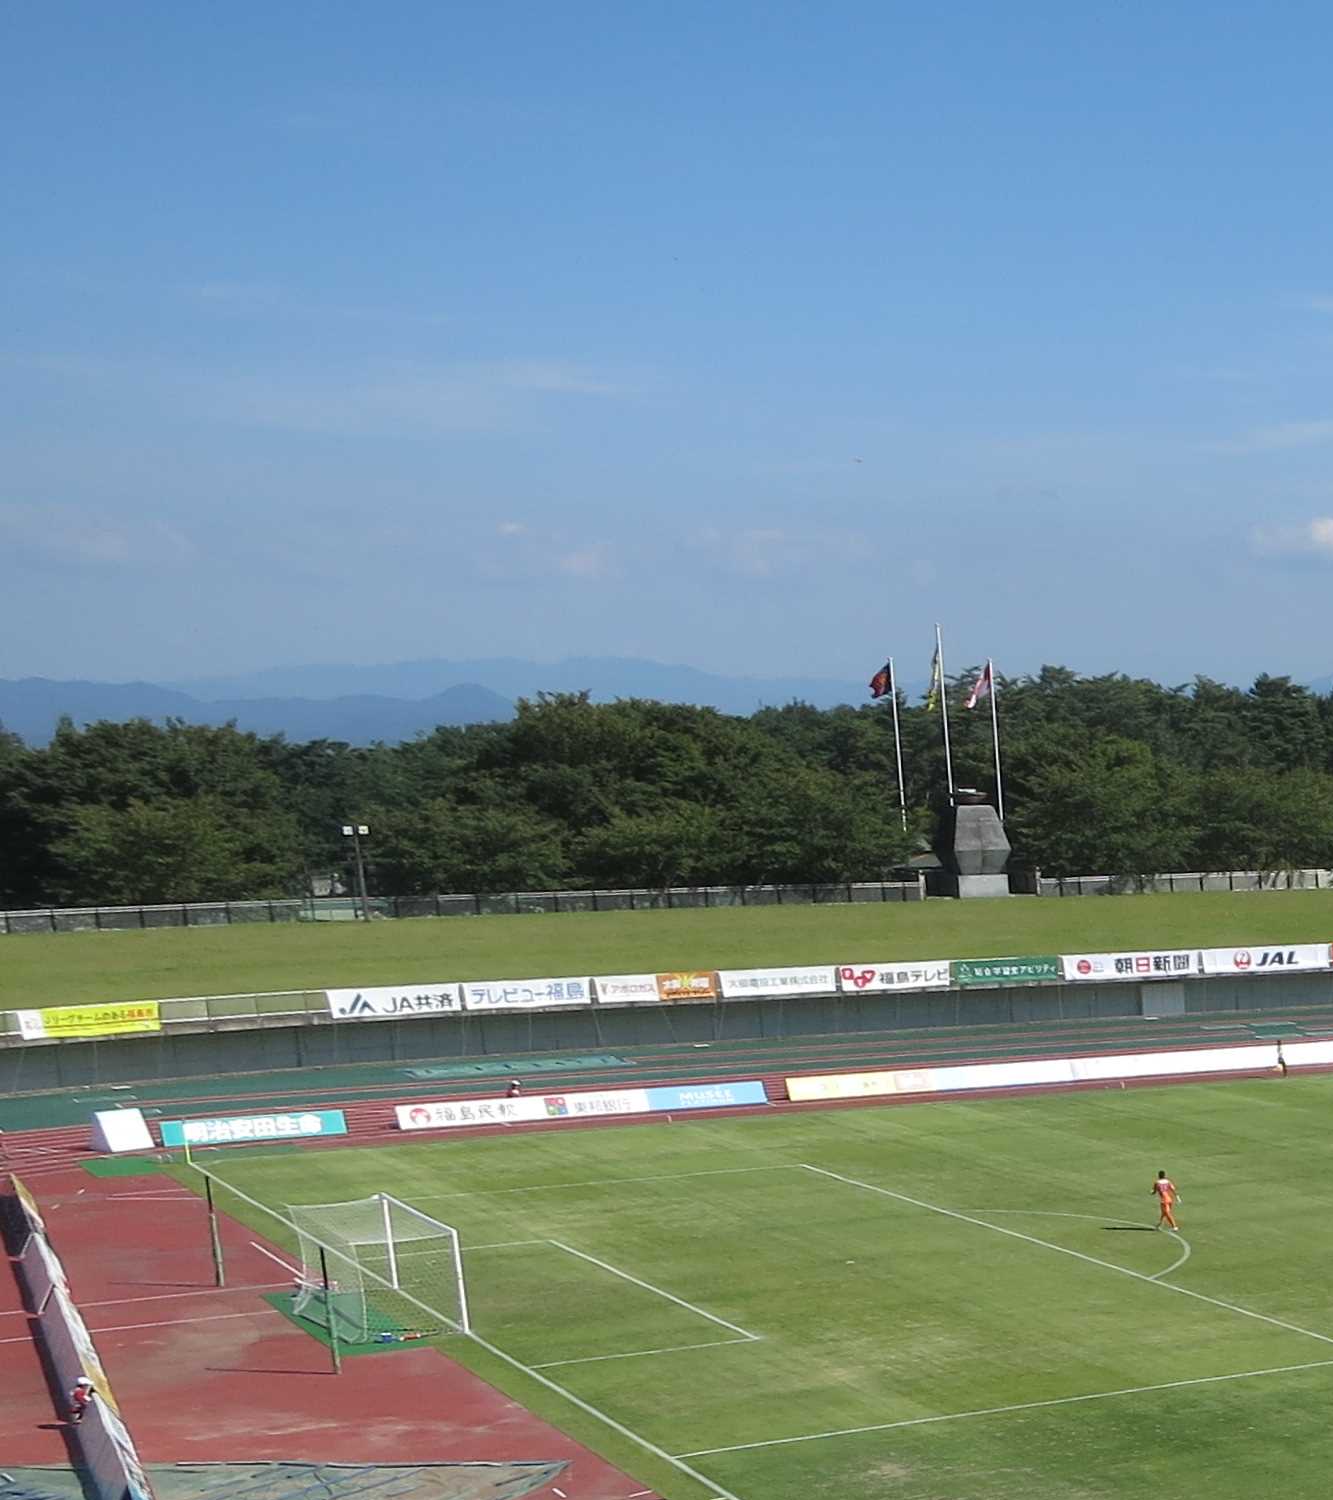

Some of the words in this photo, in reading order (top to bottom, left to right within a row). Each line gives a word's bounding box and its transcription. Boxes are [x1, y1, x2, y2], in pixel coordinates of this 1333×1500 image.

[1114, 954, 1190, 974] 朝日新聞
[1256, 951, 1300, 967] JAL
[879, 967, 949, 986] 福島テレビ
[383, 992, 454, 1014] JA共済
[470, 981, 585, 1005] テレビュー福島
